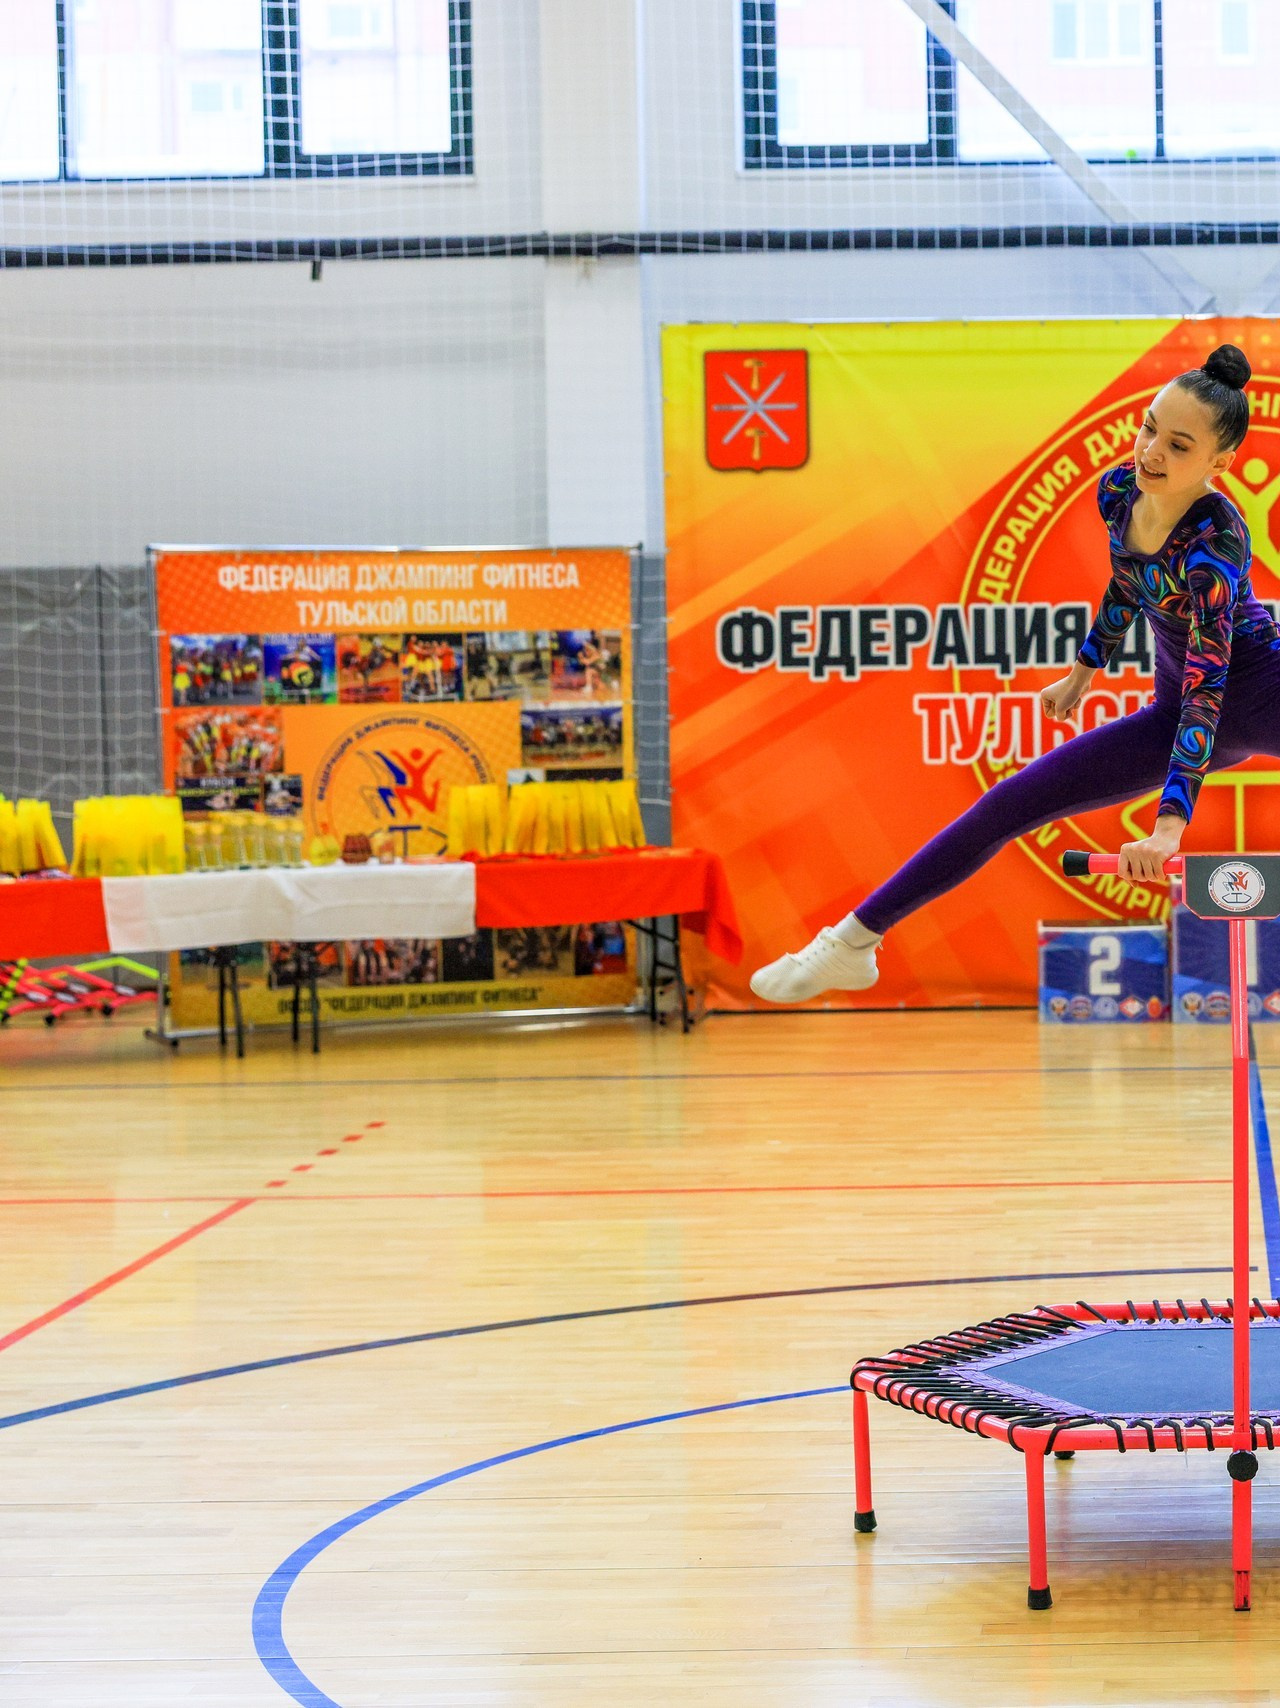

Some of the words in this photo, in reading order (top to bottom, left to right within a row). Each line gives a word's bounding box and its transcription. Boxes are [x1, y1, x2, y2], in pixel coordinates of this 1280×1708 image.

[977, 454, 1082, 605] ДЕРАЦИЯ
[217, 563, 351, 593] ФЕДЕРАЦИЯ
[354, 562, 479, 593] ДЖАМПИНГ
[482, 562, 580, 589] ФИТНЕСА
[296, 595, 408, 628] ТУЛЬСКОЙ
[411, 598, 508, 627] ОБЛАСТИ
[718, 604, 1090, 680] ФЕДЕРАЦИЯ
[1088, 935, 1122, 996] 2
